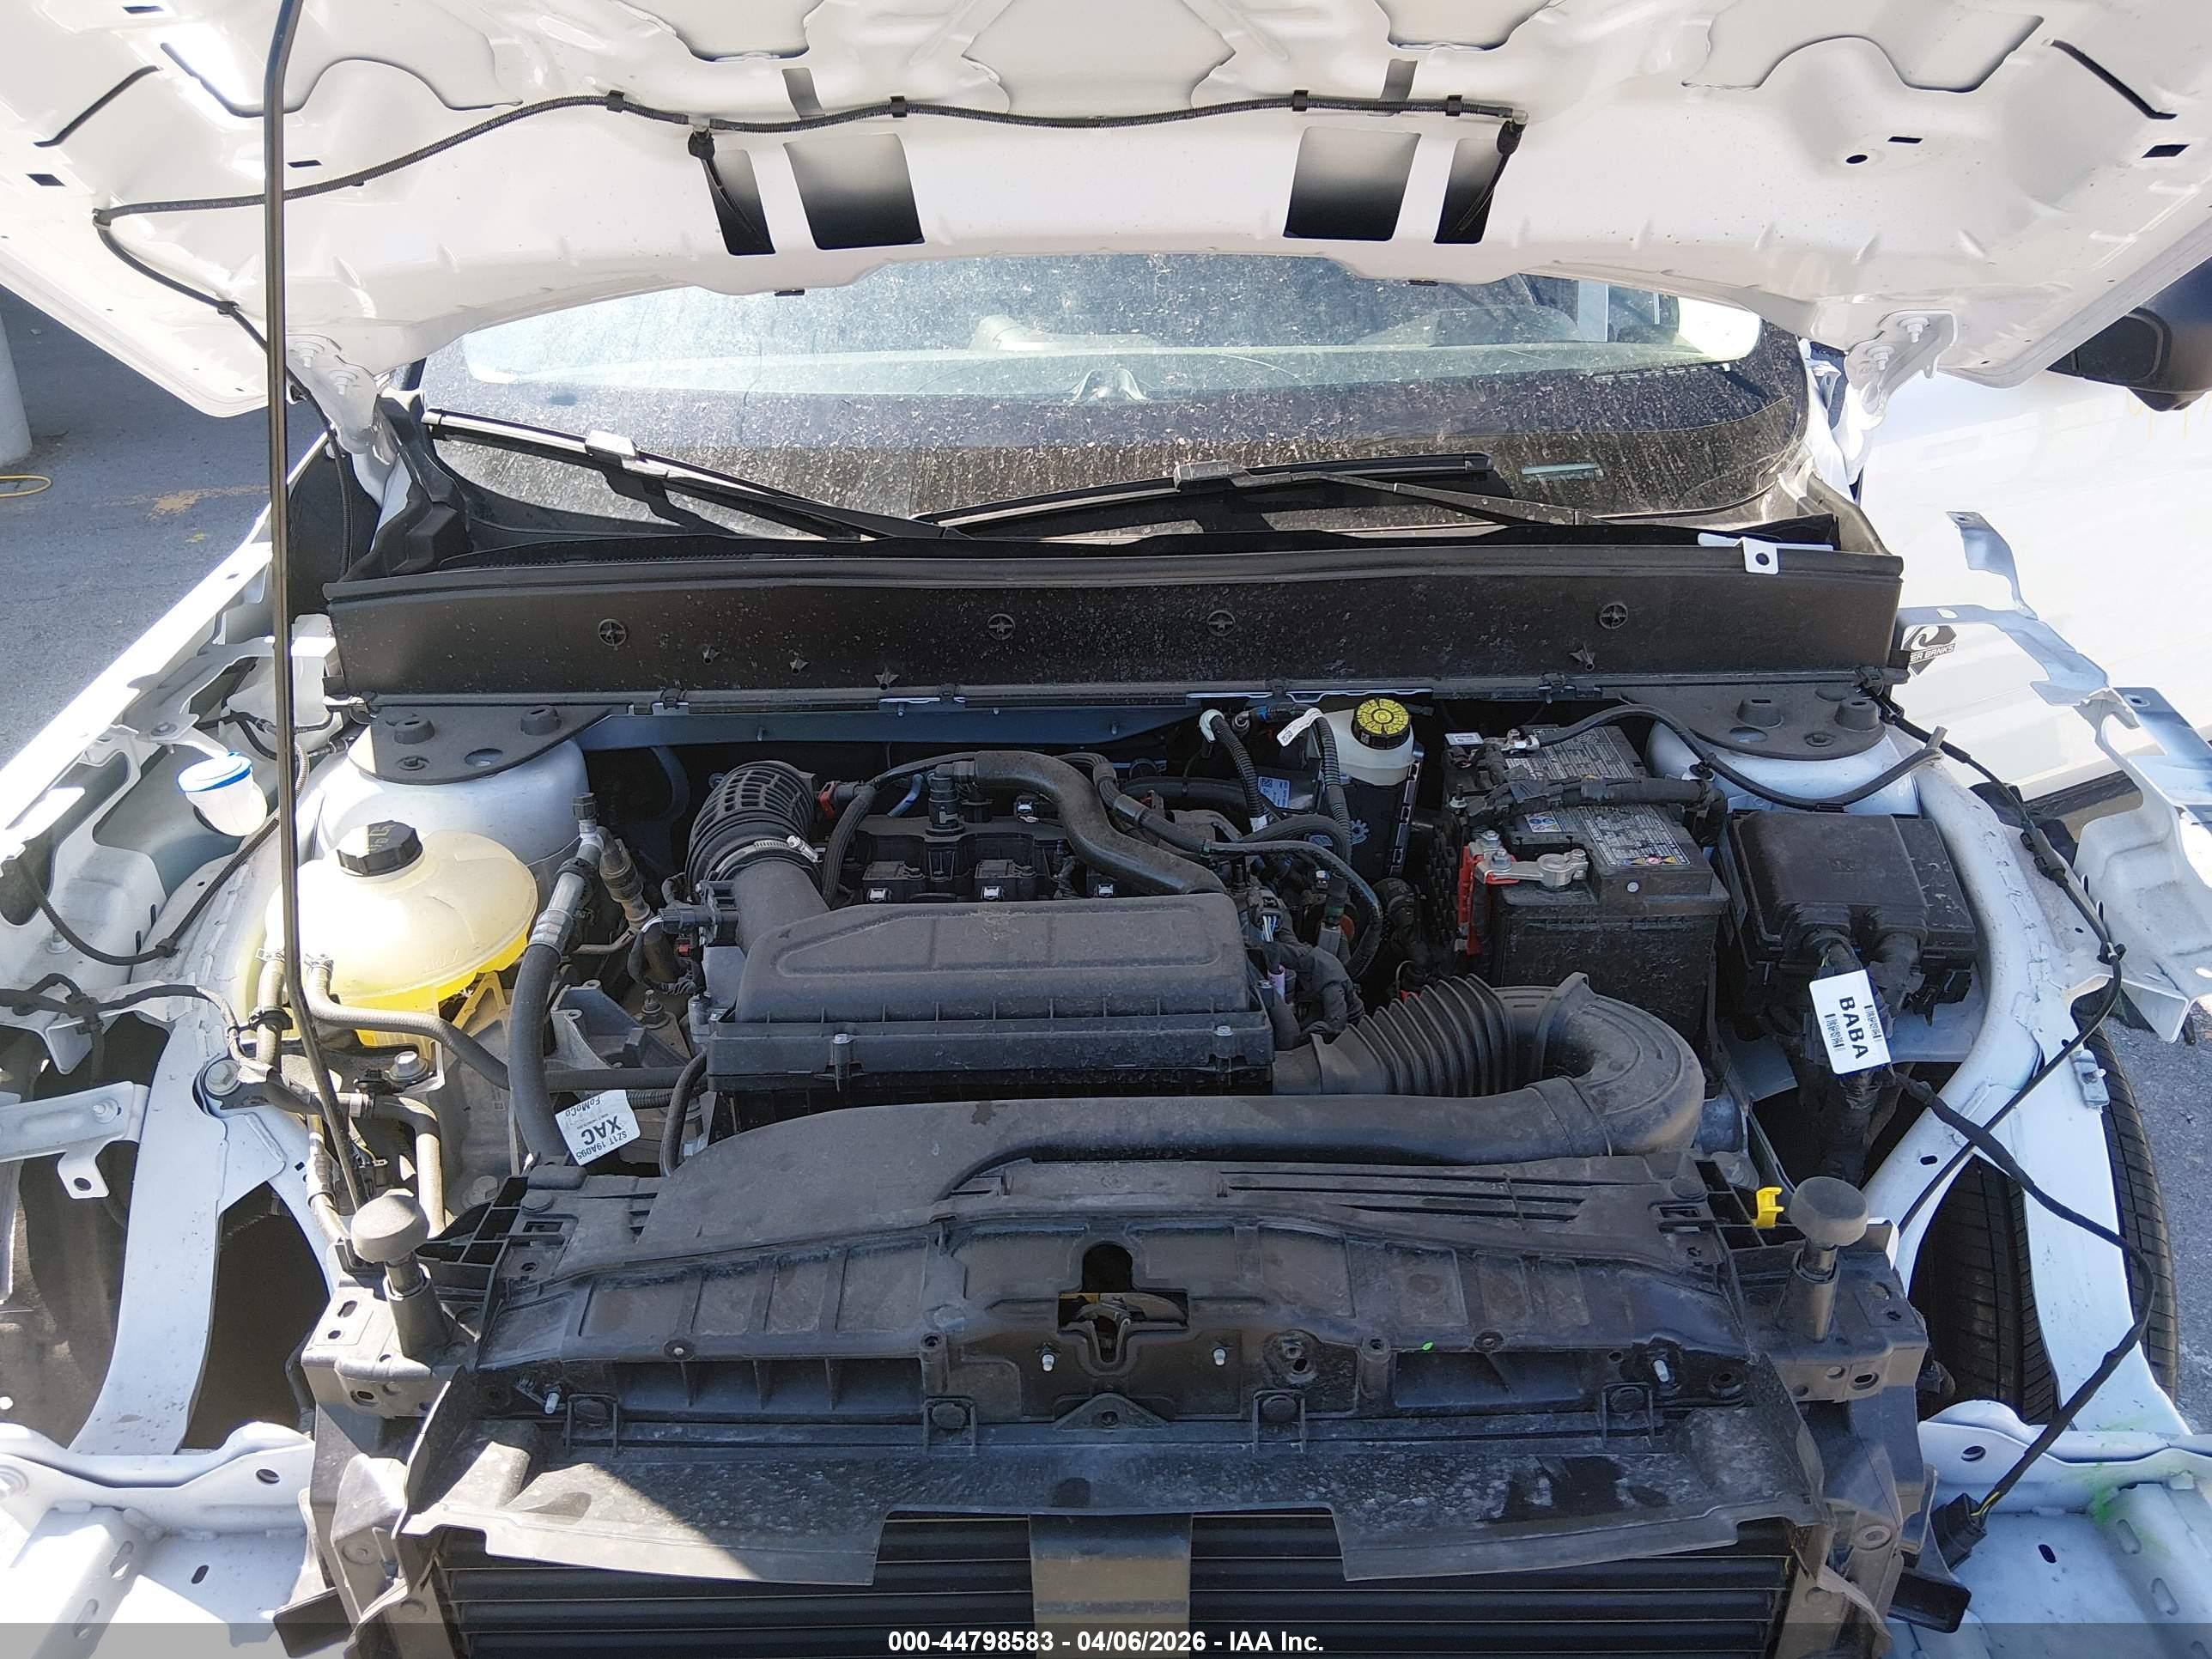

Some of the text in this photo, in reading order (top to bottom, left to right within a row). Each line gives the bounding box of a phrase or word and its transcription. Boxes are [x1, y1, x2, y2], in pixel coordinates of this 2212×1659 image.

[1923, 645, 1955, 659] BANKS
[1839, 996, 1869, 1060] BABA
[565, 1096, 601, 1117] FoMoCo
[575, 1130, 628, 1160] SZ1T 19A095
[581, 1115, 622, 1146] XAC
